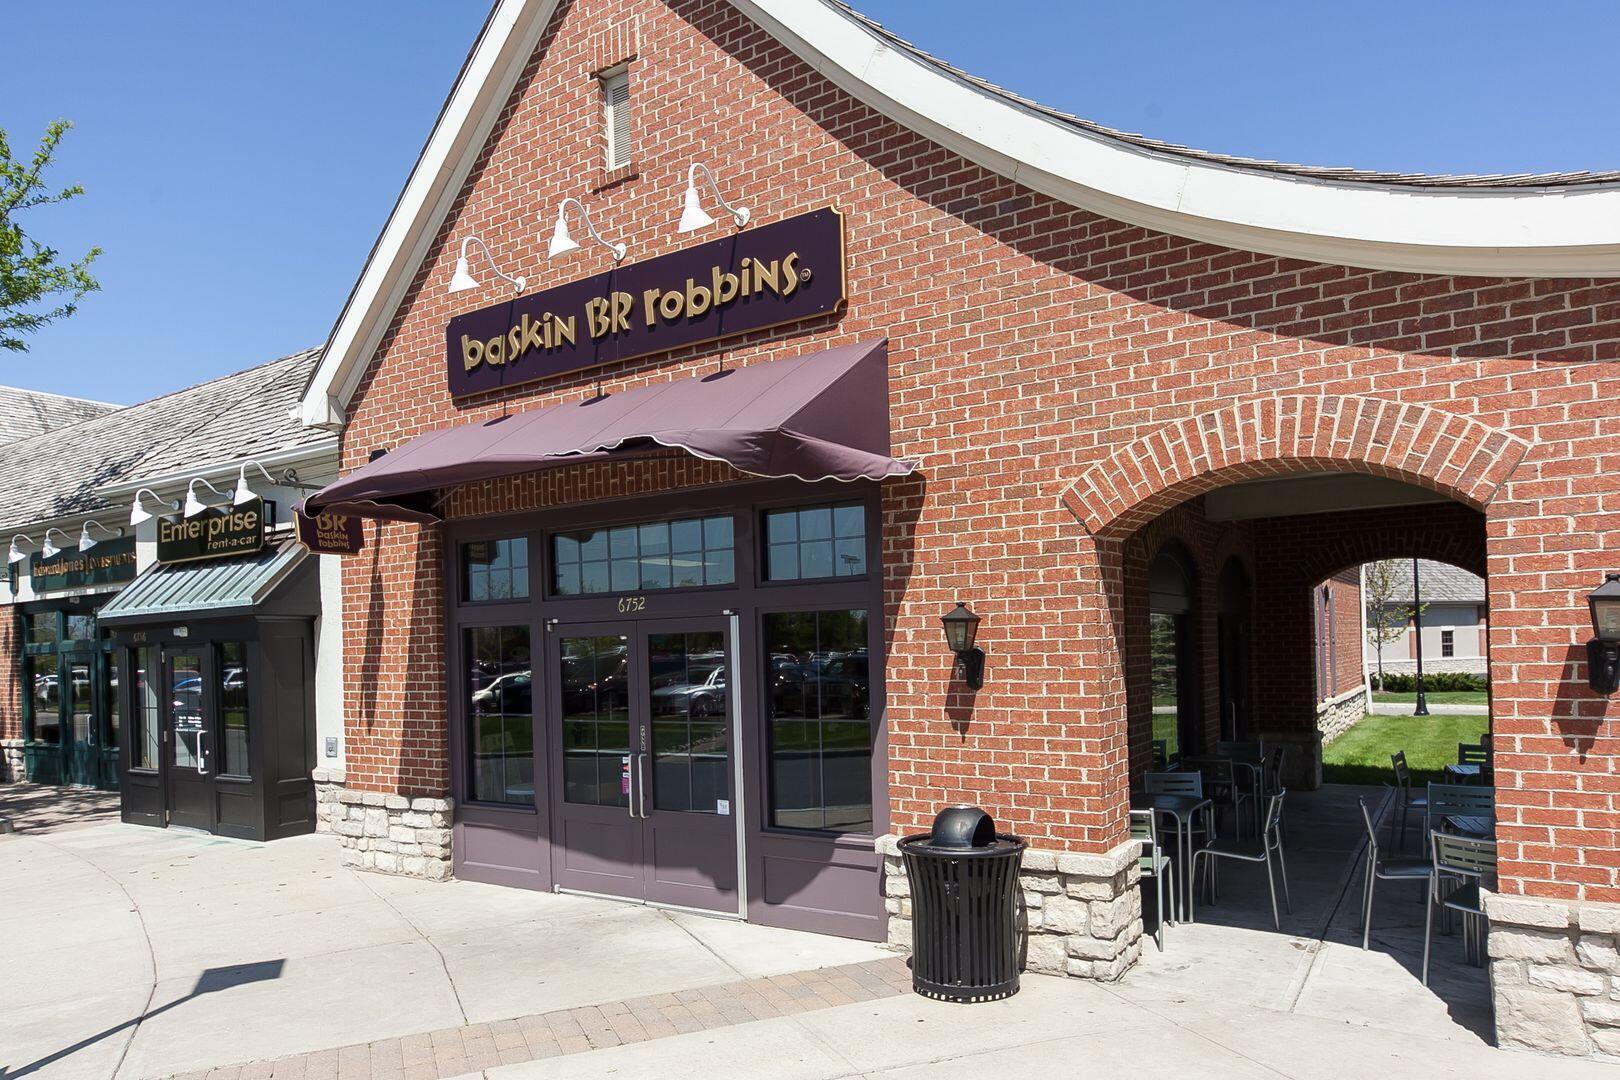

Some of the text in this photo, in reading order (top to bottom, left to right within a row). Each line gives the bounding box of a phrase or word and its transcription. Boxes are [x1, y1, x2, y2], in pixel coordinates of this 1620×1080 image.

[585, 291, 634, 339] BR
[161, 507, 257, 543] Enterprise
[316, 512, 348, 531] BR
[618, 596, 646, 613] 6752
